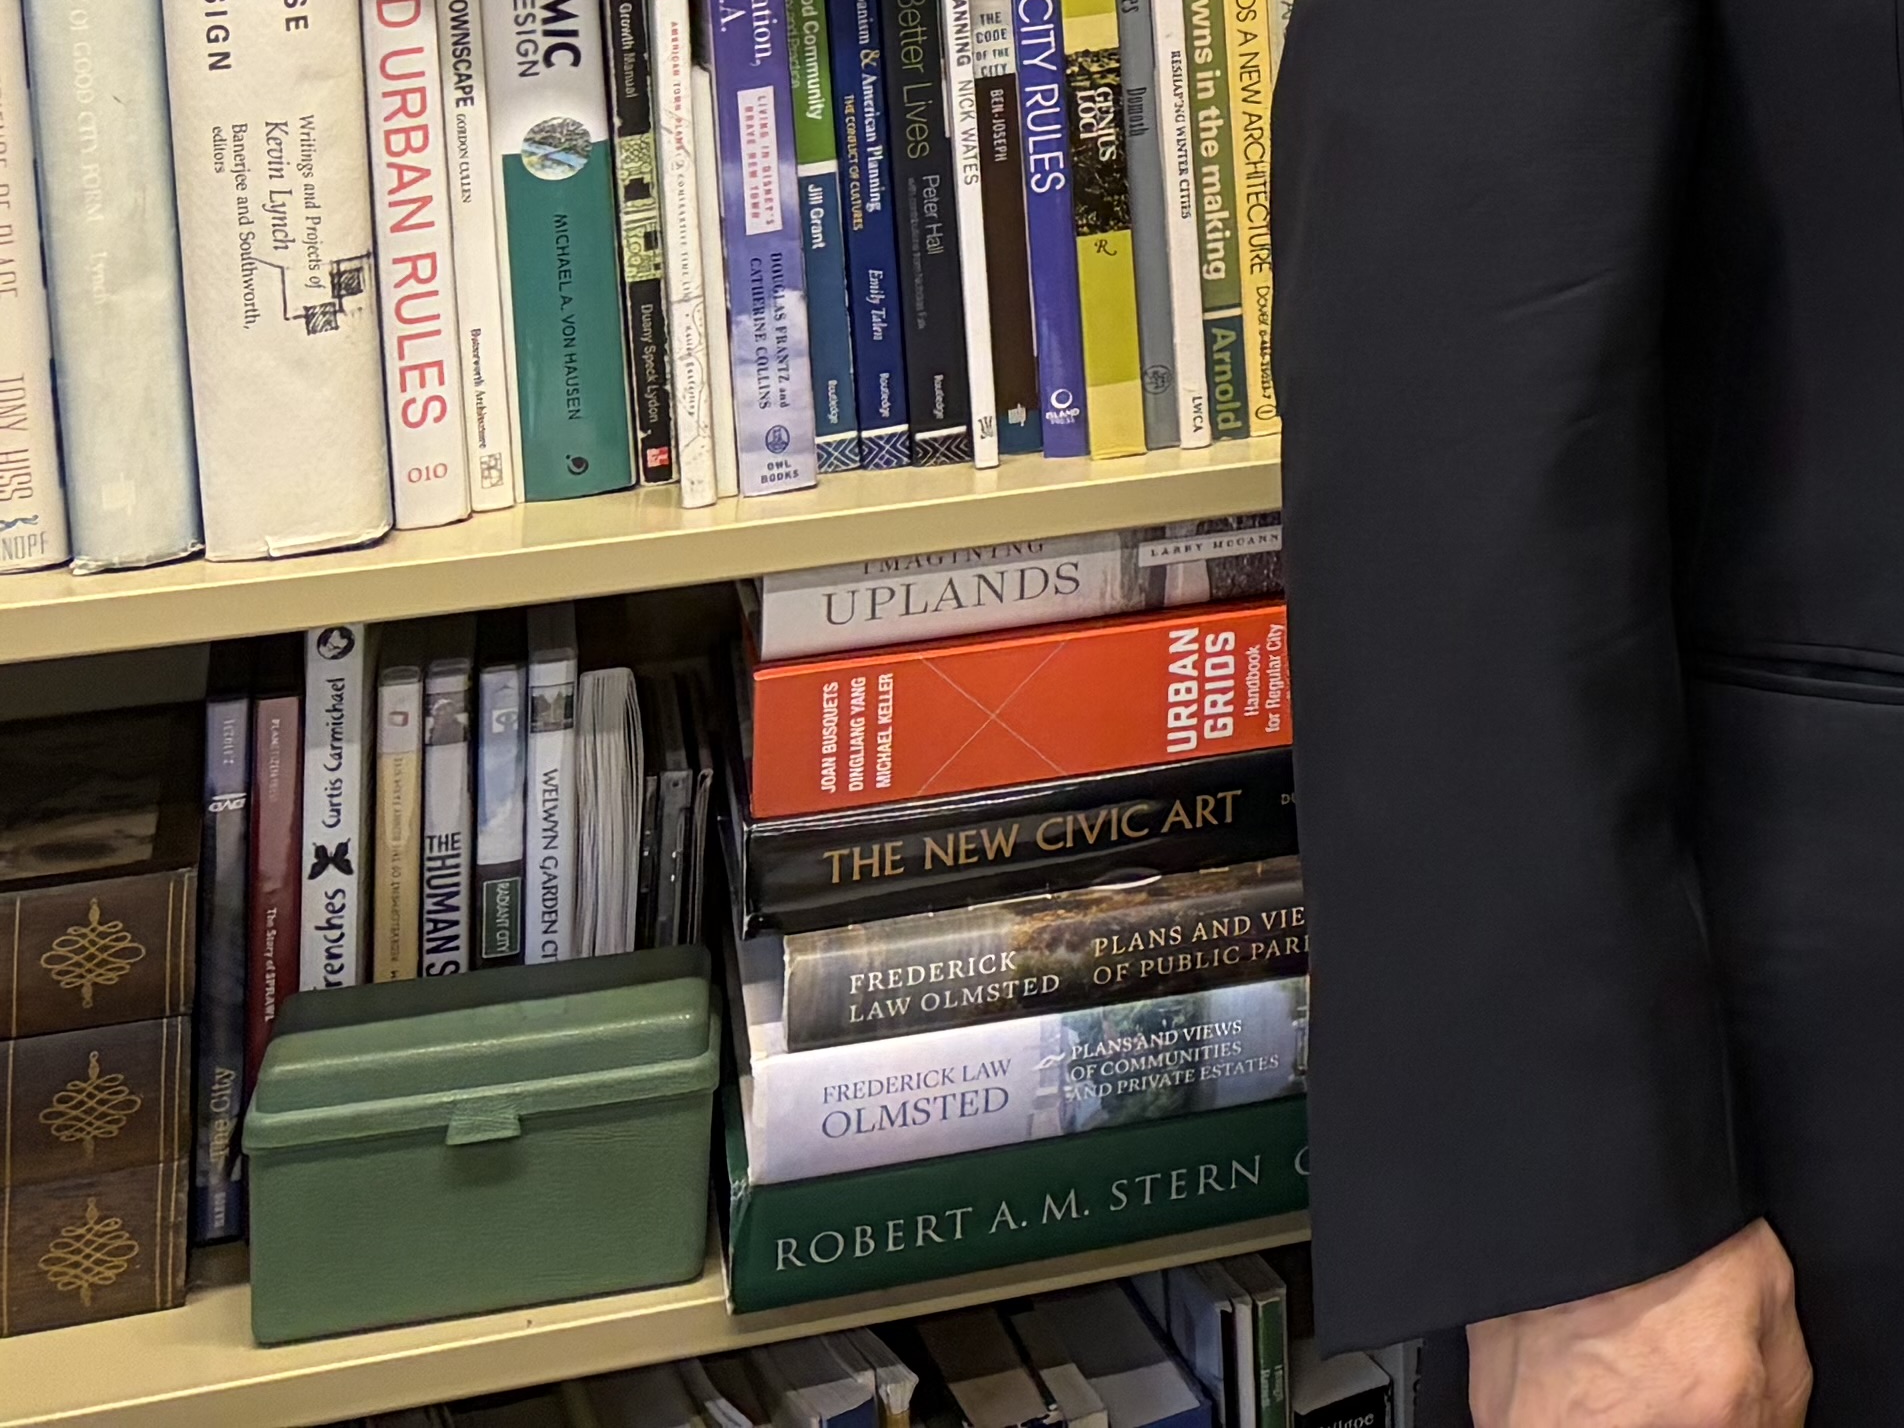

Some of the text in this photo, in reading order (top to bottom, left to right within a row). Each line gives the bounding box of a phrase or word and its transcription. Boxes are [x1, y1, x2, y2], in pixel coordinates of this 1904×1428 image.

[376, 45, 437, 235] URBAN
[389, 250, 450, 431] RULES
[822, 561, 1083, 627] UPLANDS
[1166, 625, 1199, 754] URBAN
[1201, 627, 1236, 741] GRIDS
[823, 789, 1242, 884] THE NEW CIVIC ART
[820, 1084, 1011, 1139] OLMSTED
[822, 1056, 1013, 1104] FREDERICK LAW
